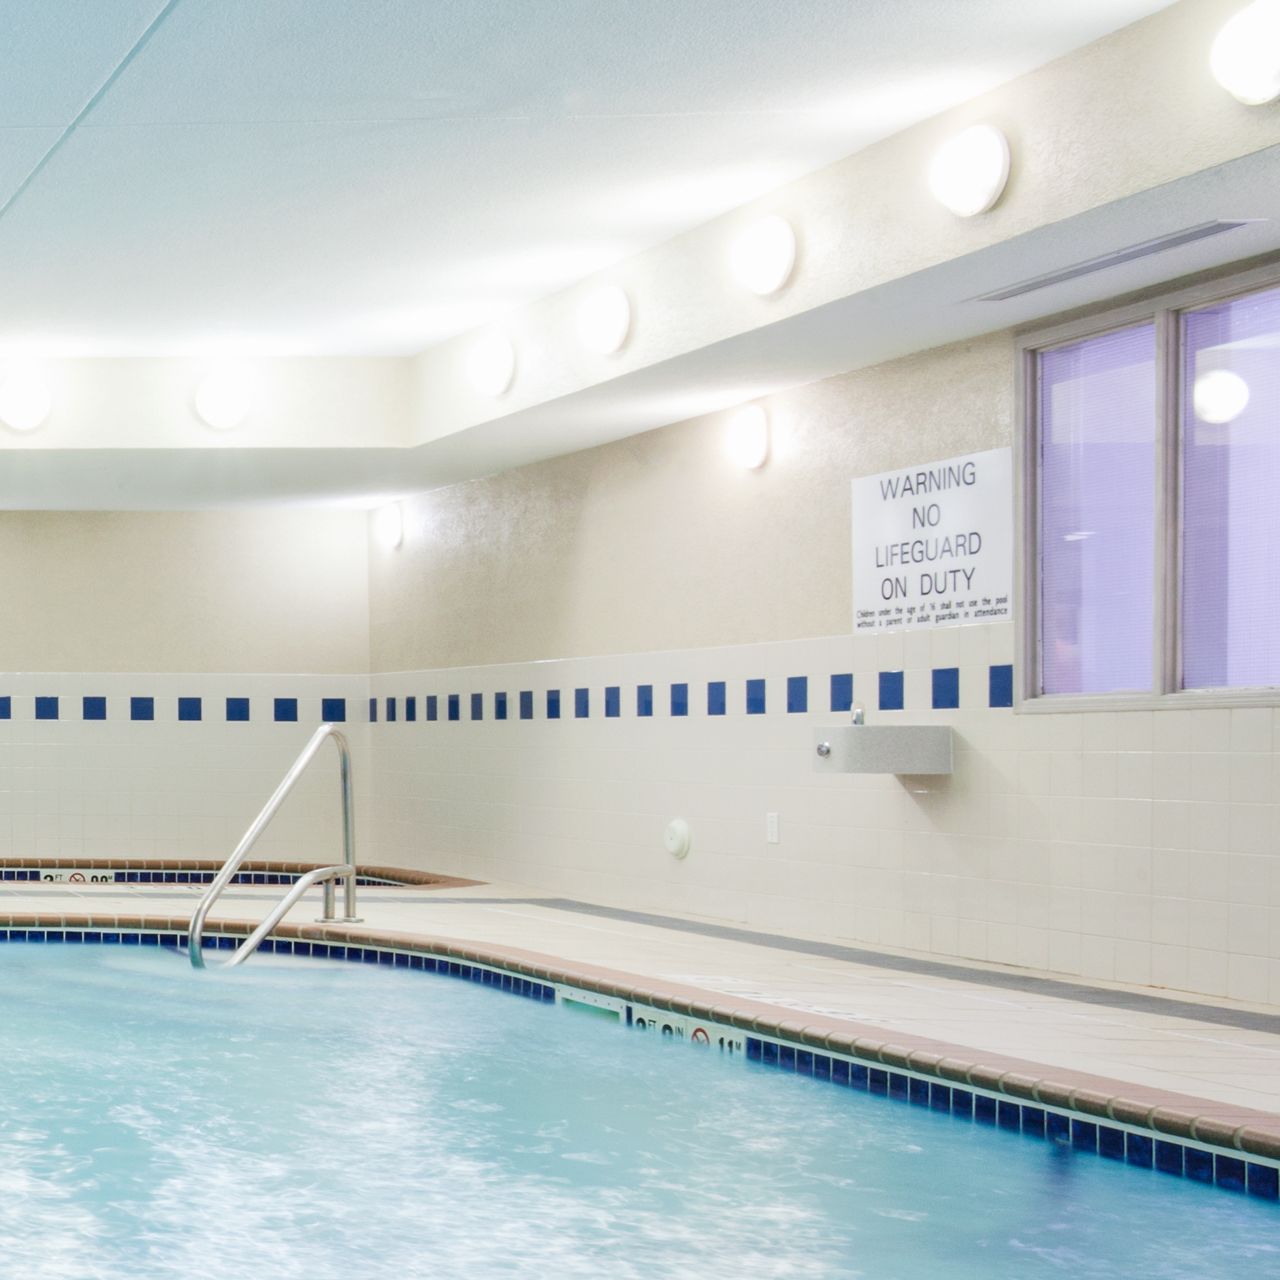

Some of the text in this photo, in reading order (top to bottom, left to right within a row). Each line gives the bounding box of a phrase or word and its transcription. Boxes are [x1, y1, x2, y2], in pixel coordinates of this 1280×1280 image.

[879, 461, 976, 501] WARNING
[912, 503, 941, 529] NO
[875, 531, 982, 568] LIFEGUARD
[881, 567, 976, 601] ON DUTY
